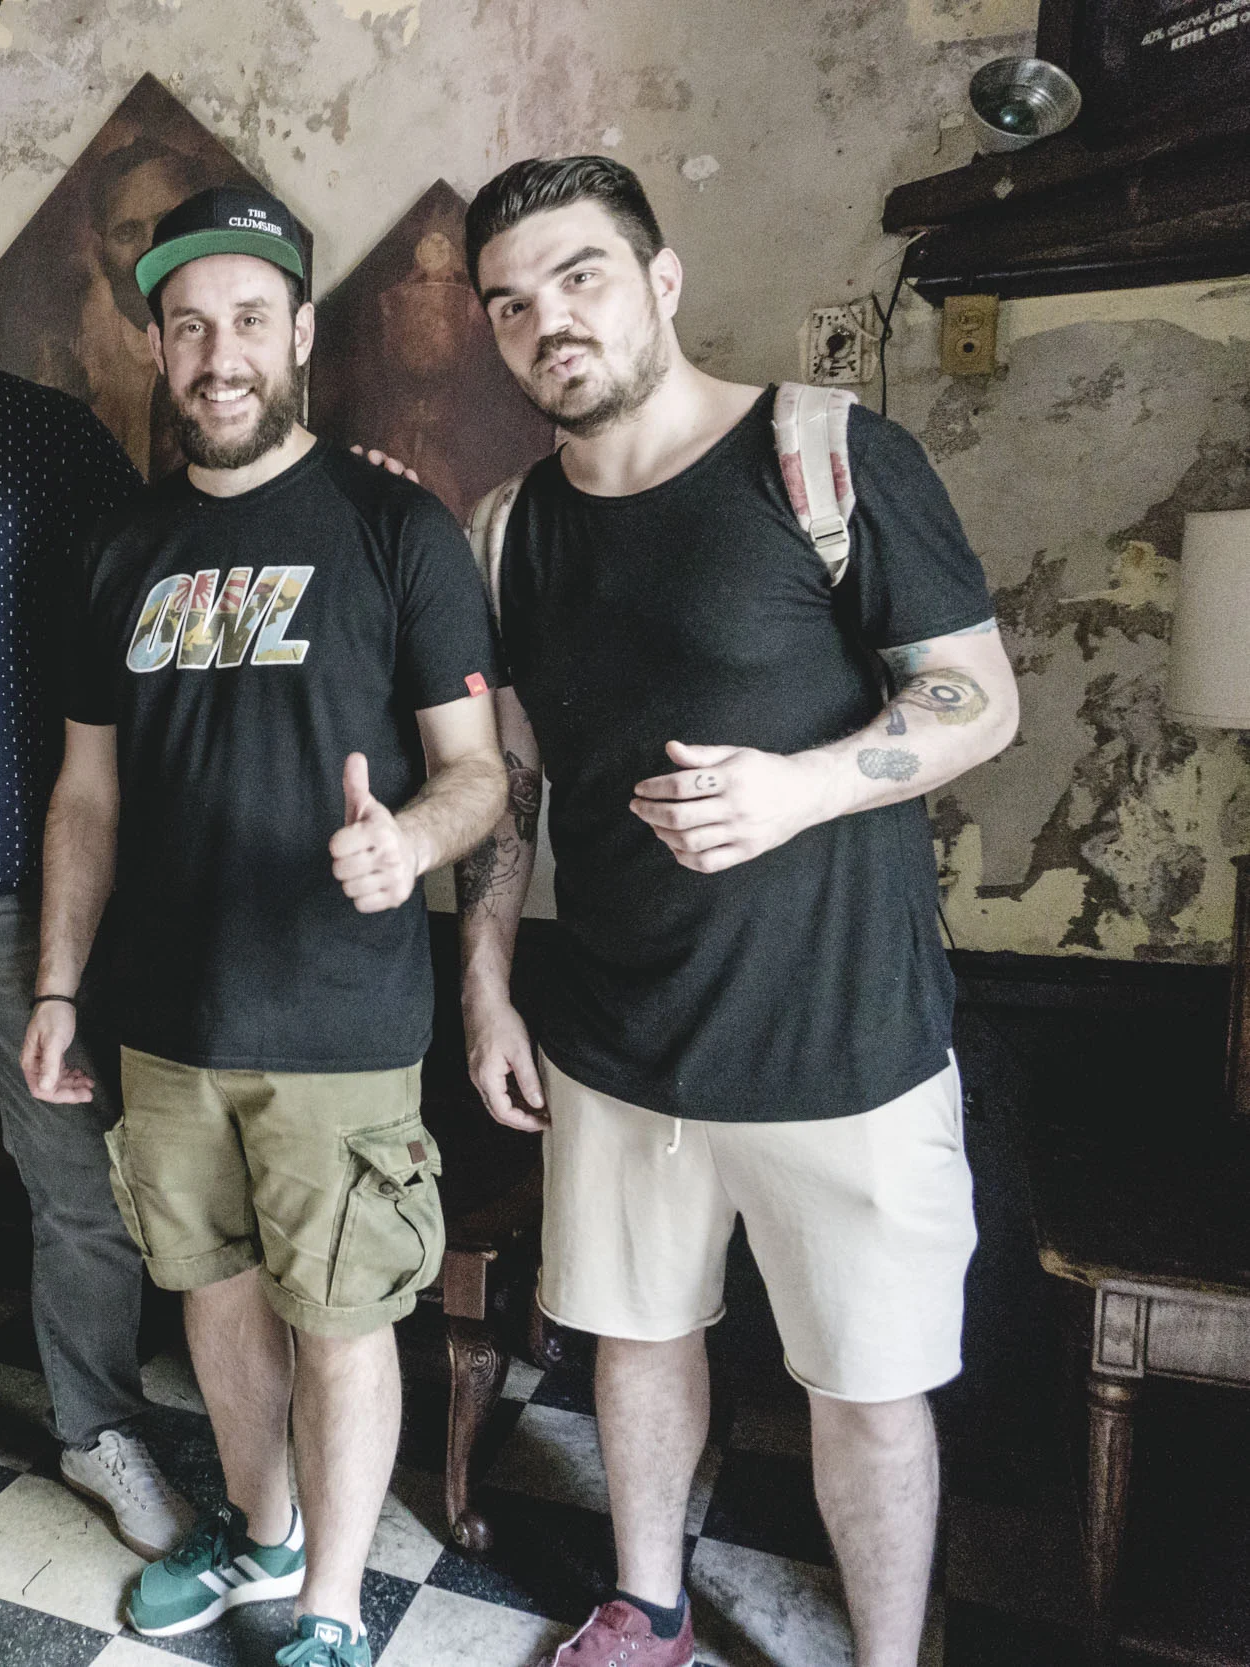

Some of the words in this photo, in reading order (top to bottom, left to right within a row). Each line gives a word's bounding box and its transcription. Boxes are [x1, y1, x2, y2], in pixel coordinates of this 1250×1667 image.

[248, 208, 267, 219] THE
[229, 216, 282, 236] CLUMSIES
[126, 566, 315, 673] OWL
